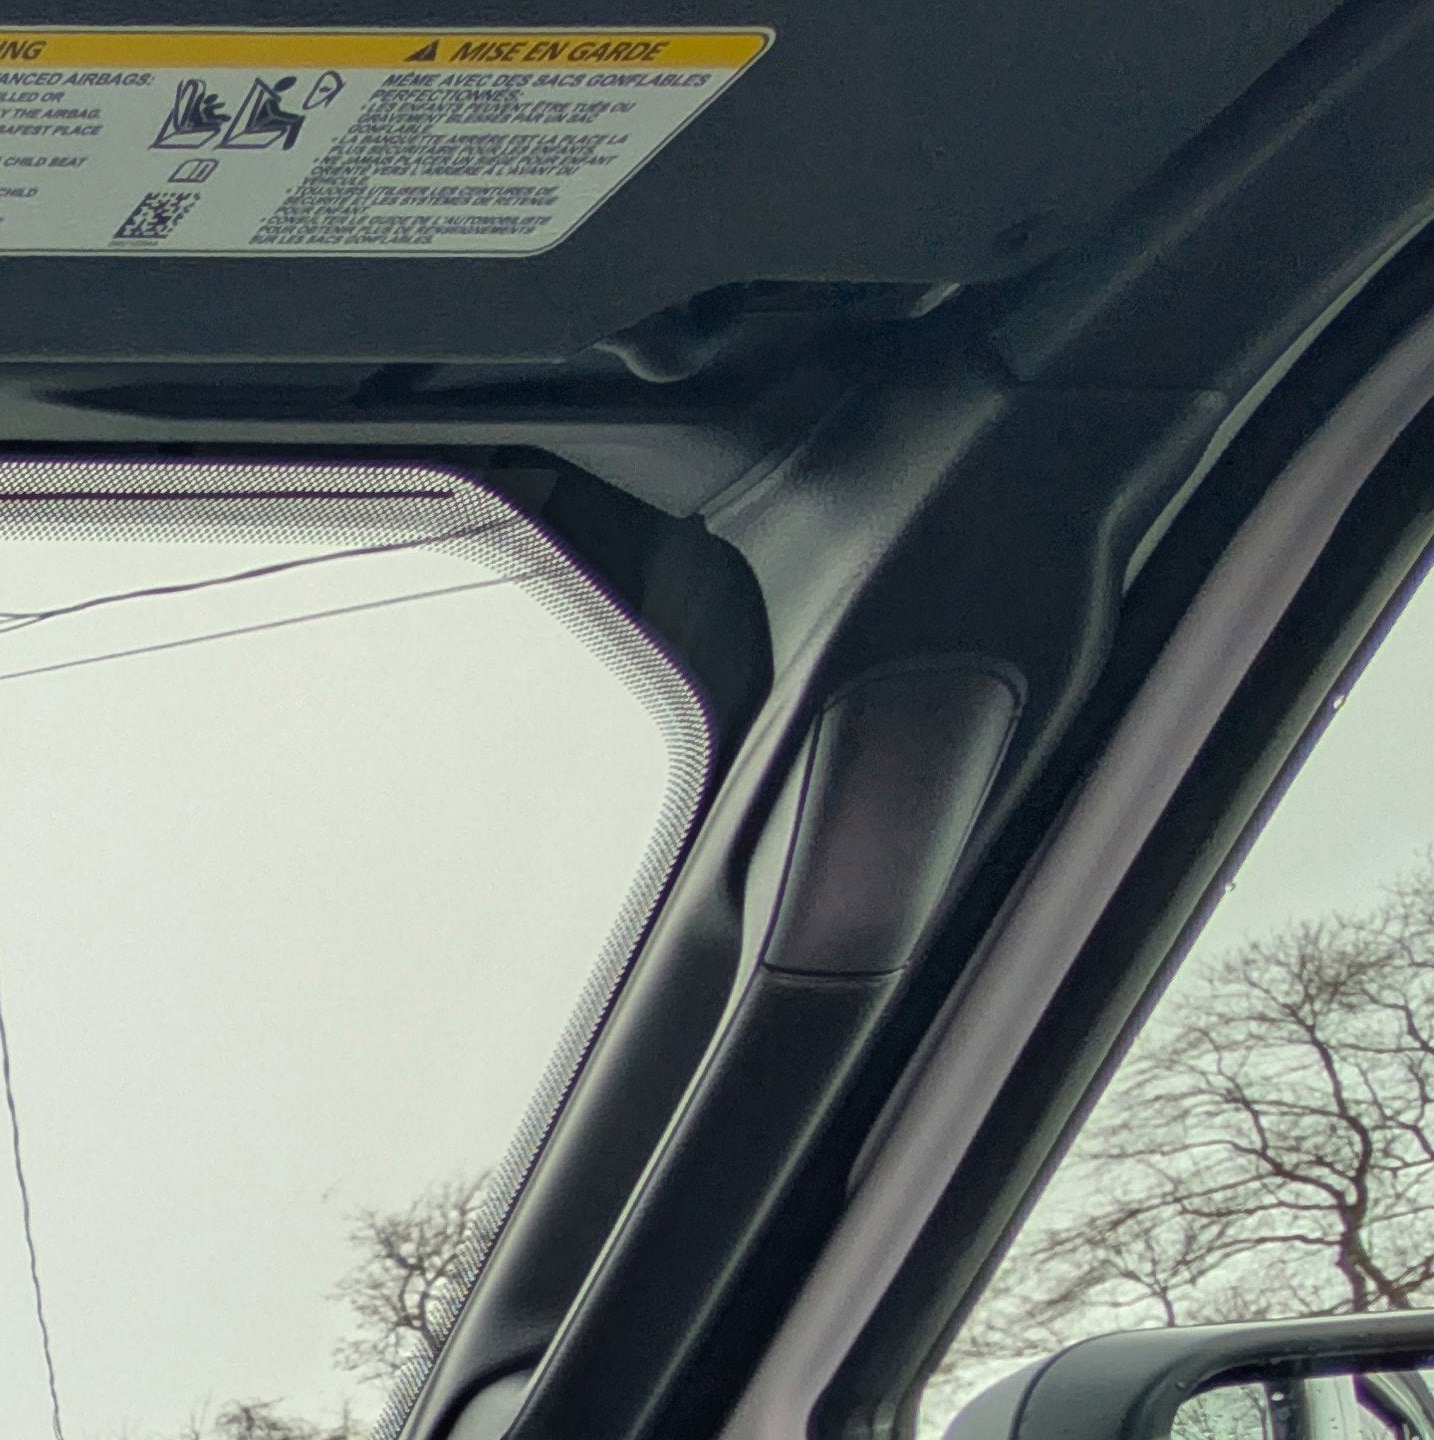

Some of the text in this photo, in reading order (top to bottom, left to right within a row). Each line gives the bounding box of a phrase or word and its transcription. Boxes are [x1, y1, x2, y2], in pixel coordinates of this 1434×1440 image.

[448, 40, 669, 62] MISE EN GARDE
[63, 73, 156, 87] AIRBAGS:
[382, 70, 714, 88] MÊME AVEC DES SACS GONFLABLES
[38, 92, 65, 103] OR
